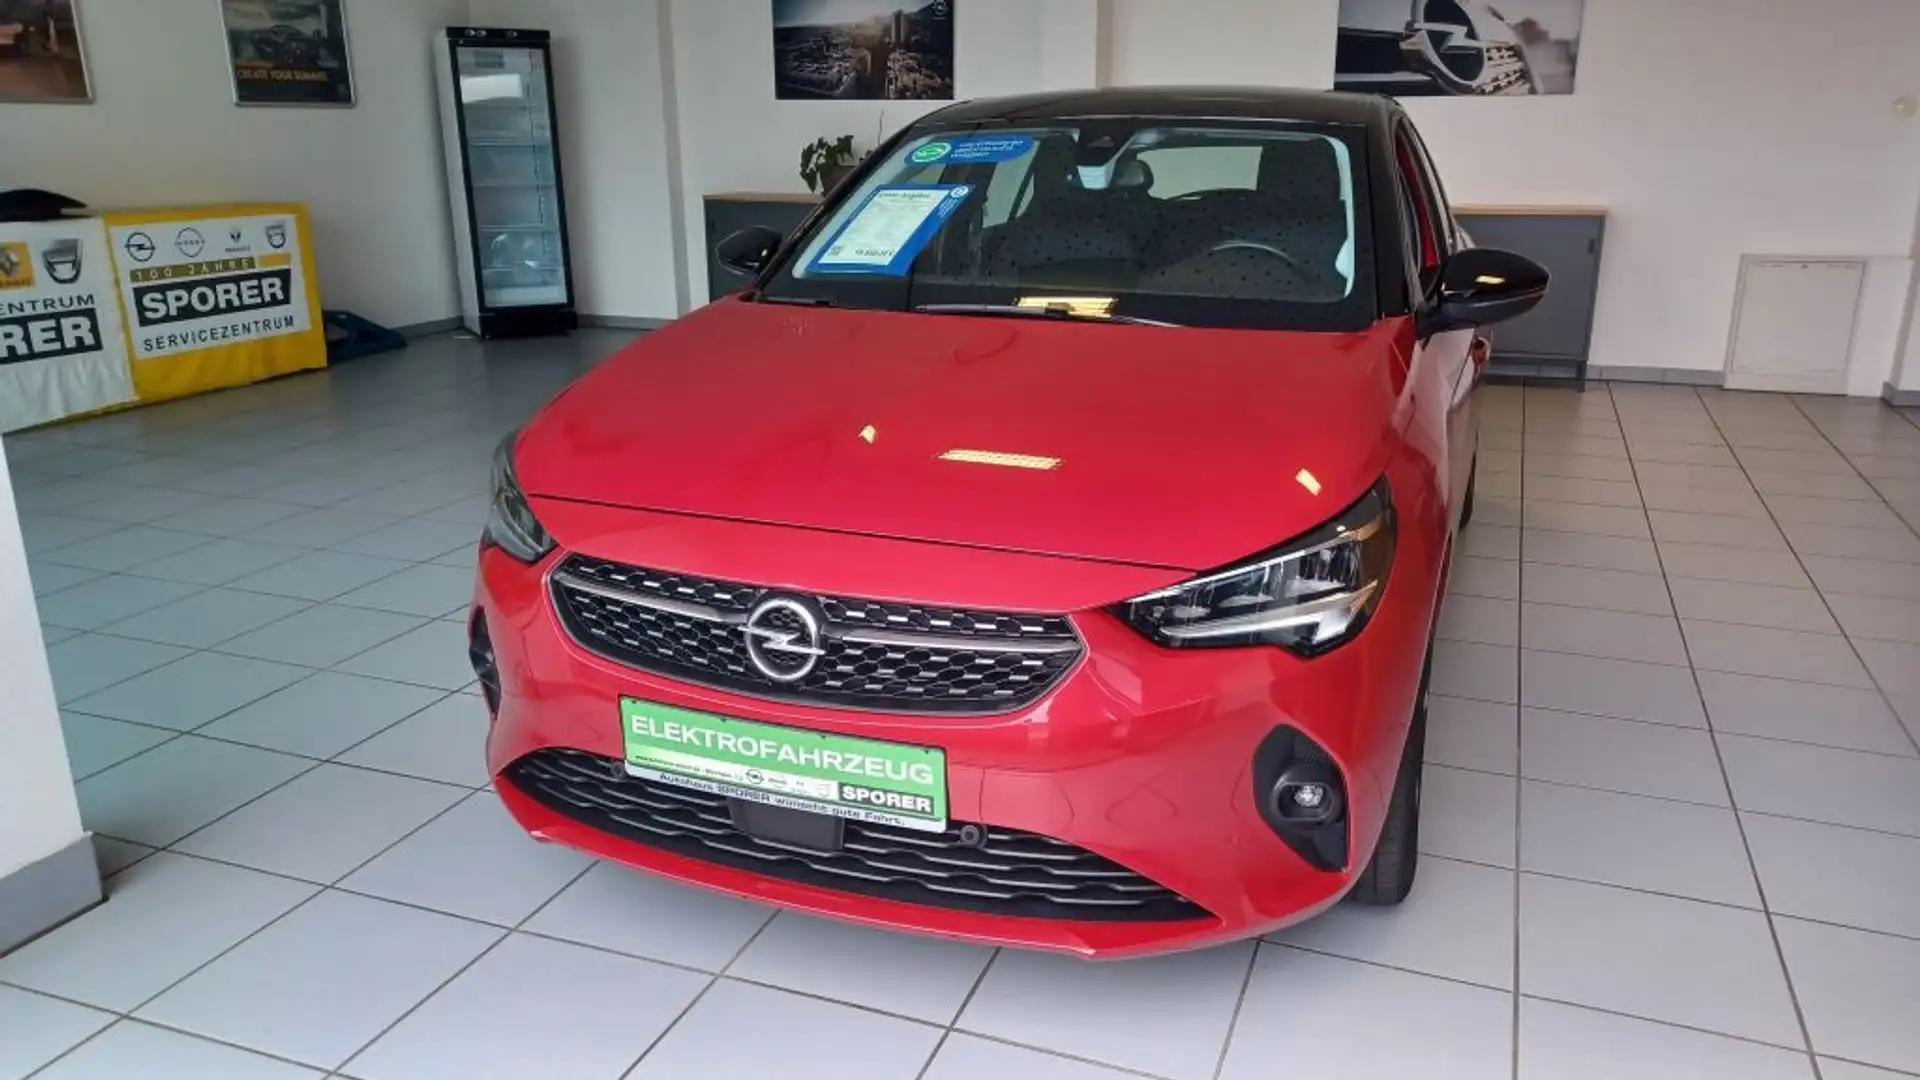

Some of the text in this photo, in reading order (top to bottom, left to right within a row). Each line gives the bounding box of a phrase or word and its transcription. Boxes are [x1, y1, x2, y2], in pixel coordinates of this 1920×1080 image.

[135, 259, 251, 280] 100 JAHRE
[142, 277, 284, 320] SPORER
[144, 315, 294, 351] SERVICEZENTRUM
[631, 714, 934, 785] ELEKTROFAHRZEUG
[841, 785, 931, 812] SPORER
